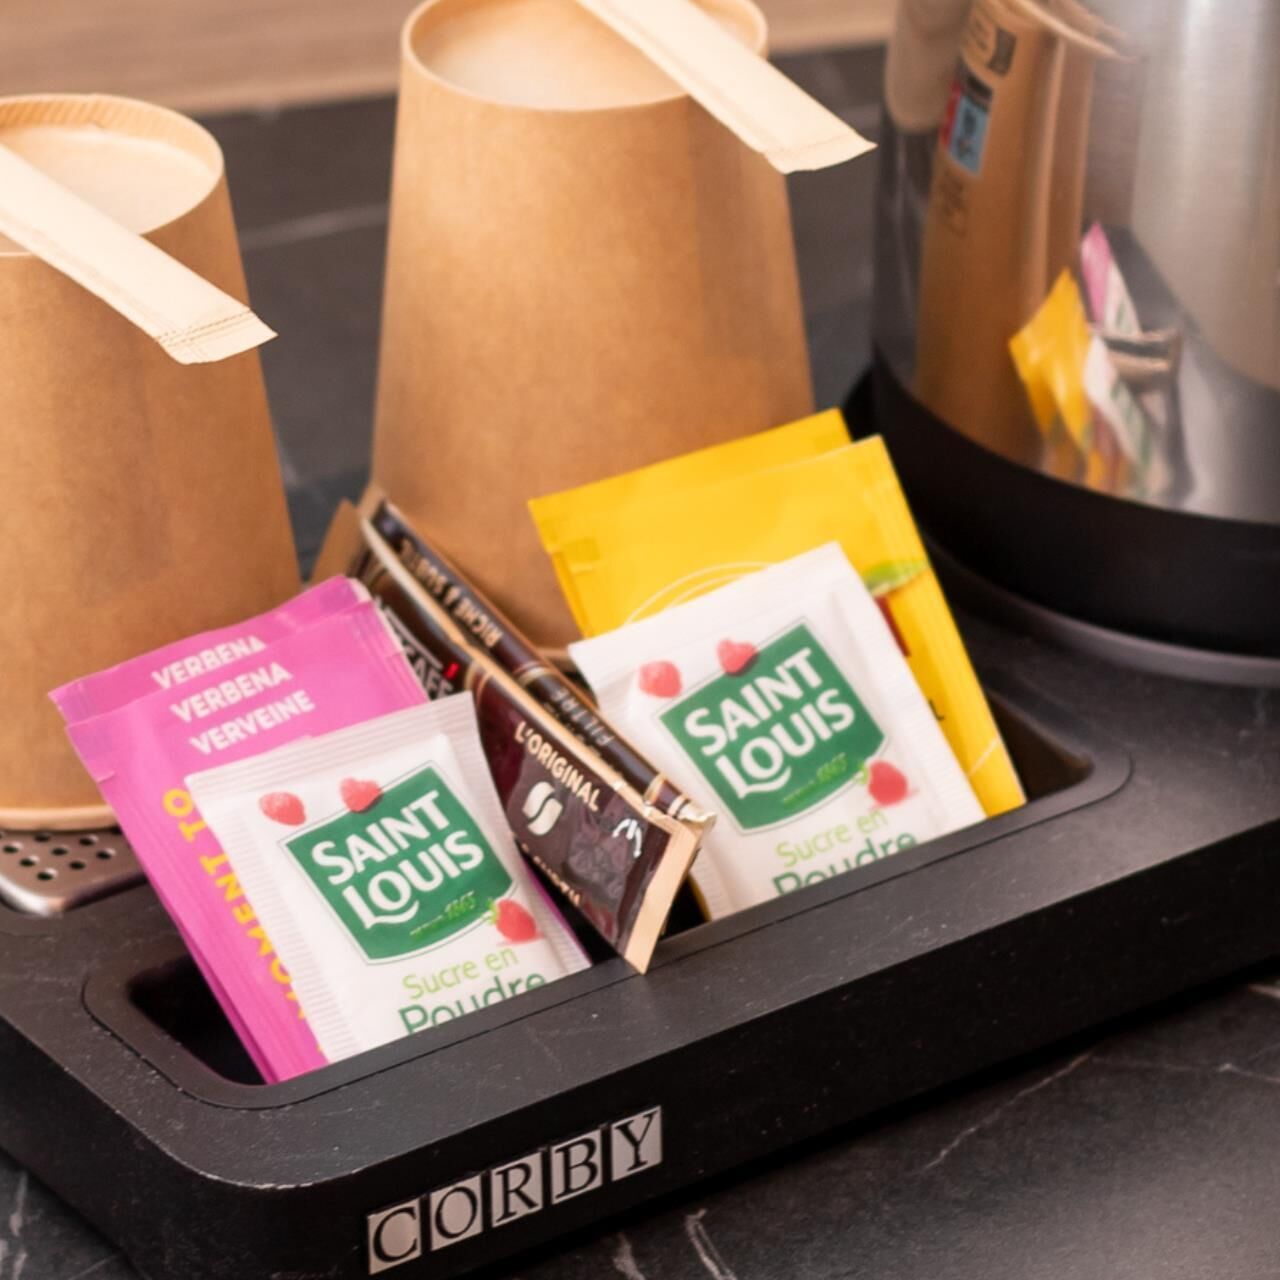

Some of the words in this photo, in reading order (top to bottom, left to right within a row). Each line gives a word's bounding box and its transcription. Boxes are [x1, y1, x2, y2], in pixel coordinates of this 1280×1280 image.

[151, 635, 266, 689] VERBENA
[170, 661, 294, 723] VERBENA
[189, 689, 315, 755] VERVEINE
[550, 687, 615, 747] FILTRE
[685, 647, 822, 756] SAINT
[515, 721, 601, 812] L'ORIGINAL
[715, 689, 854, 799] LOUIS
[162, 788, 206, 842] TO
[312, 790, 450, 885] SAINT
[776, 824, 852, 867] Sucre
[856, 810, 888, 834] en
[342, 830, 484, 929] LOUIS
[403, 960, 480, 999] Sucre
[485, 948, 518, 971] en
[369, 1109, 660, 1268] CORBY
